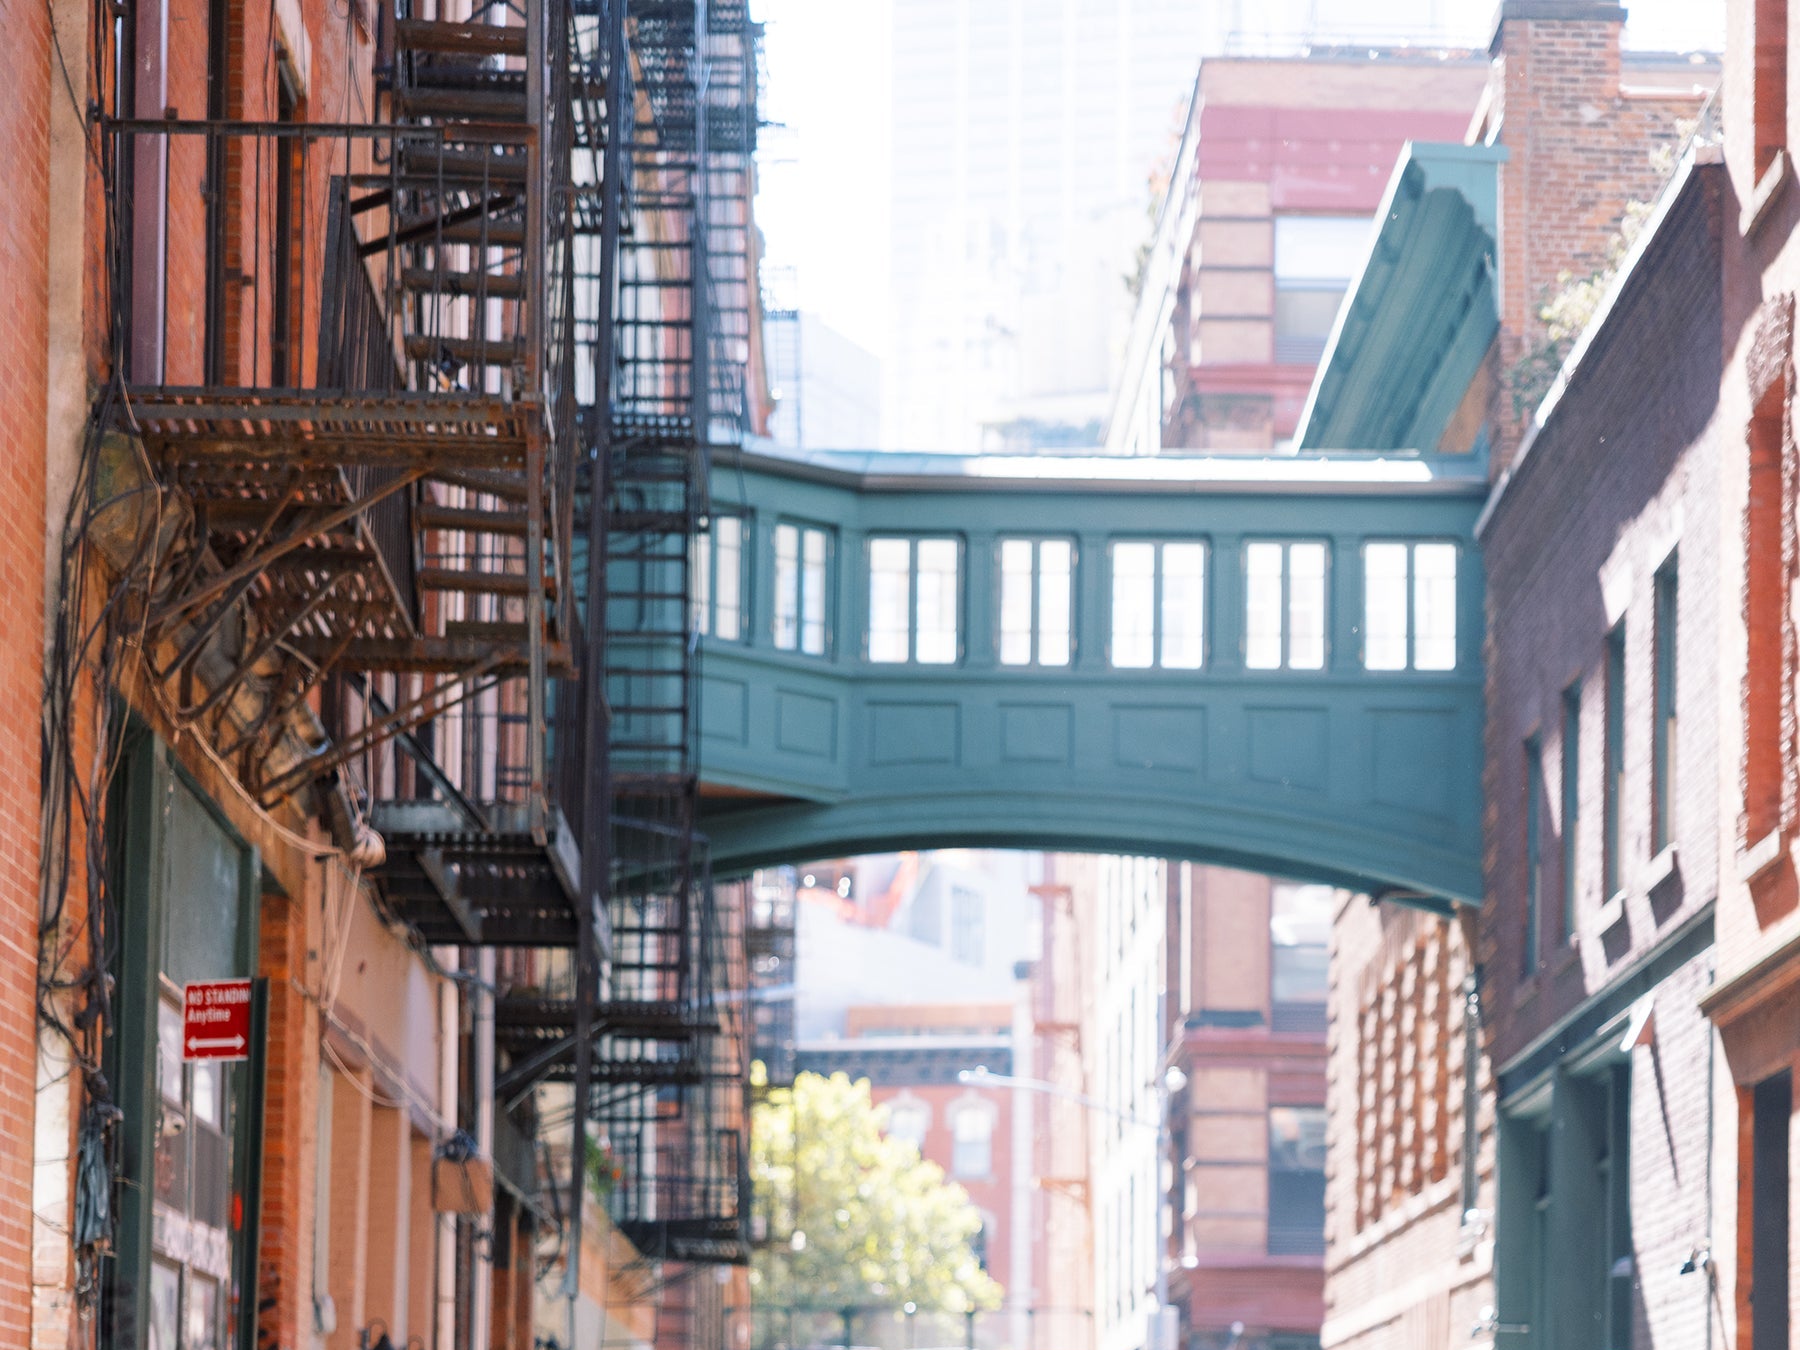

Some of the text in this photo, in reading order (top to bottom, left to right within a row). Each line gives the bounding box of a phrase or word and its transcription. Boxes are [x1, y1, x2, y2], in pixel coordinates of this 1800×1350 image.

[188, 987, 251, 1006] NO STANDIN
[188, 1006, 231, 1026] Anytime
